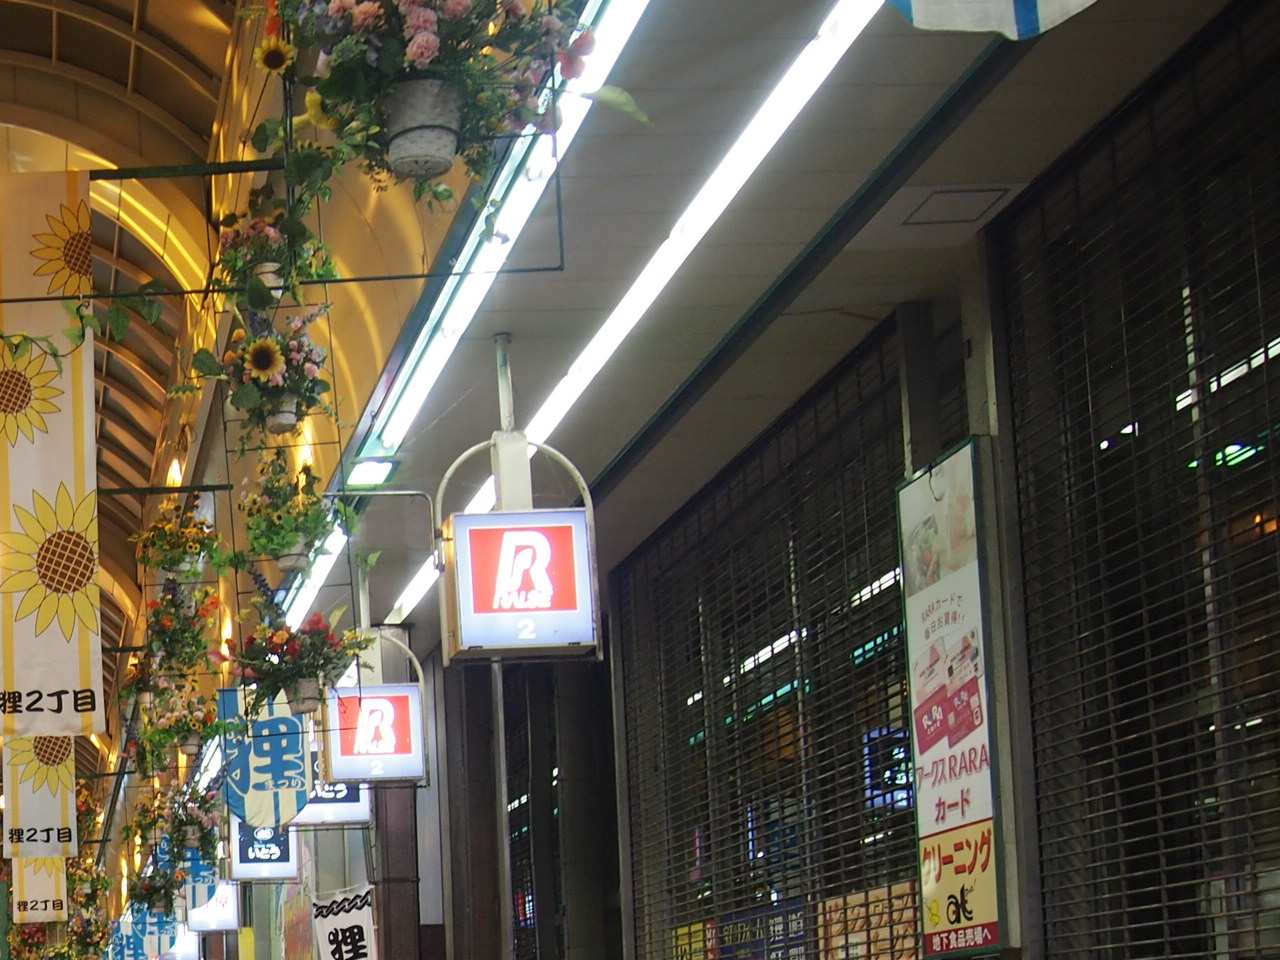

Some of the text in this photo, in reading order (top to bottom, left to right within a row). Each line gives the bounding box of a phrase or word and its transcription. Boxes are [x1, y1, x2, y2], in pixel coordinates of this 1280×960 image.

[517, 620, 536, 640] 2
[0, 688, 97, 715] 狸2丁目
[935, 788, 971, 822] カード
[8, 827, 73, 844] 狸2丁目
[922, 828, 993, 886] クリーニング
[932, 926, 992, 952] 地下食品売場へ
